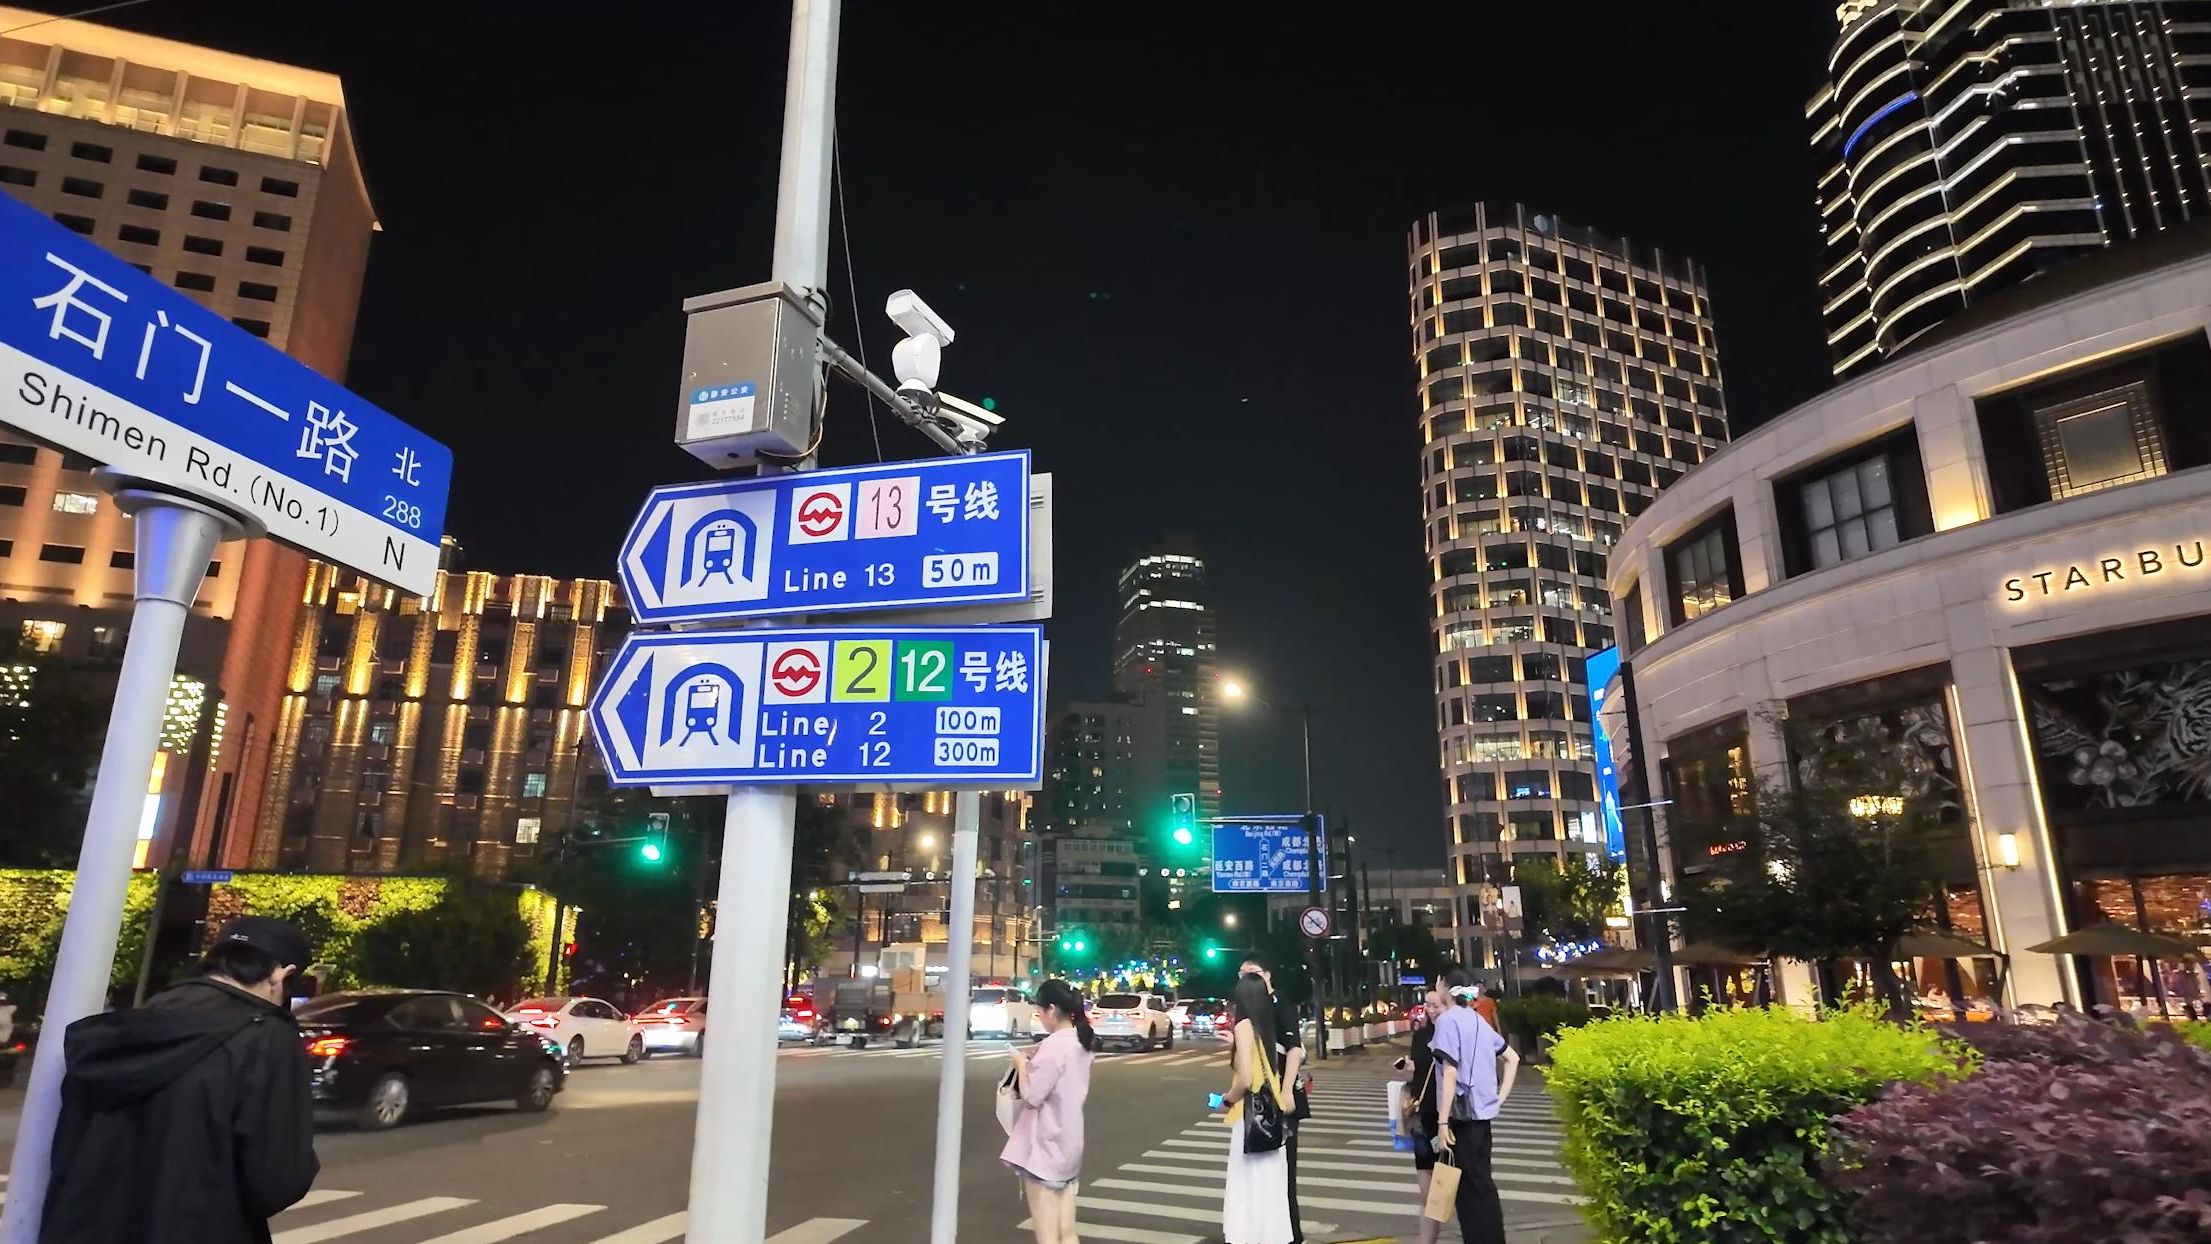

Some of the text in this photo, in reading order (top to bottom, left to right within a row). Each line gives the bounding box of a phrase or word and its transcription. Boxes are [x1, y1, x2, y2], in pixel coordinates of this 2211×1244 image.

[32, 251, 360, 484] 石门一路
[18, 371, 406, 572] Shimen Rd. (No.1) N
[391, 446, 422, 488] 北
[382, 494, 422, 530] 288
[871, 480, 1000, 531] 13 号线
[783, 557, 992, 593] Line 13 50m
[2005, 541, 2204, 601] STARBU
[844, 645, 1029, 695] 2 12 号线
[760, 710, 997, 737] Line 2 100m
[757, 741, 997, 768] Line 12 300m
